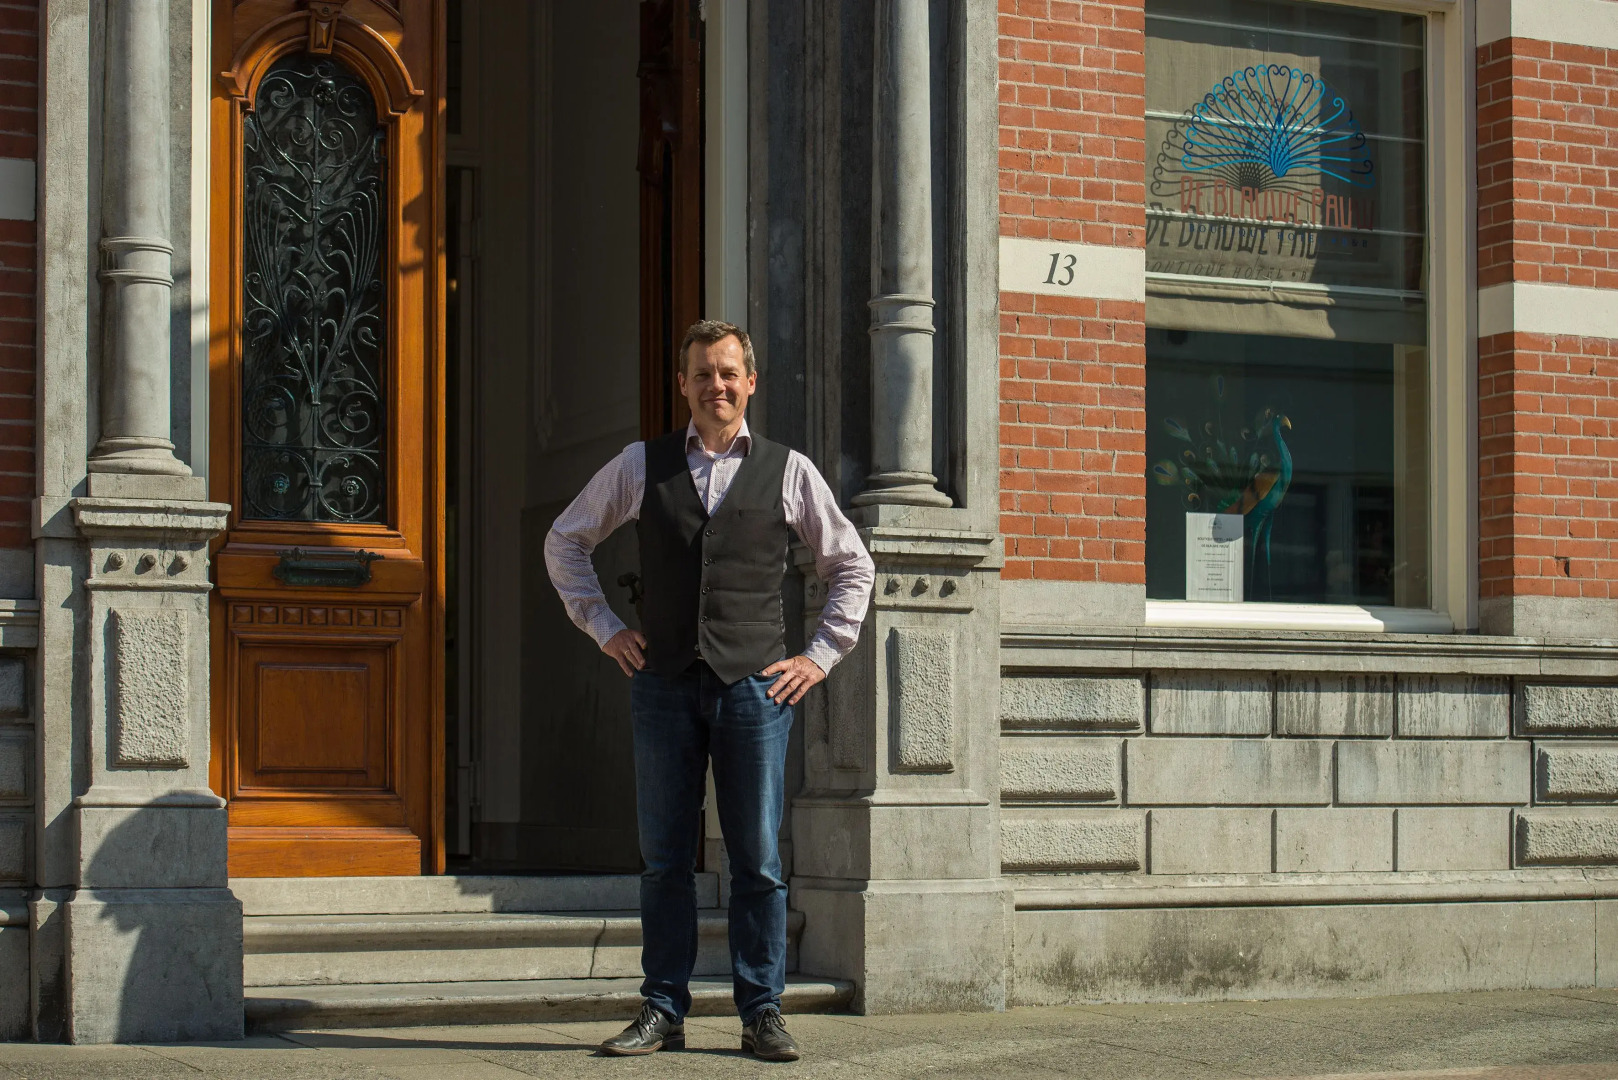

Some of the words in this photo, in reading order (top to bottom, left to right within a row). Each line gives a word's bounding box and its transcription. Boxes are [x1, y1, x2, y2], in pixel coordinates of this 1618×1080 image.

[1180, 175, 1206, 215] DE
[1213, 178, 1303, 224] BLAUWE
[1311, 188, 1375, 230] PAUW
[1042, 252, 1077, 286] 13
